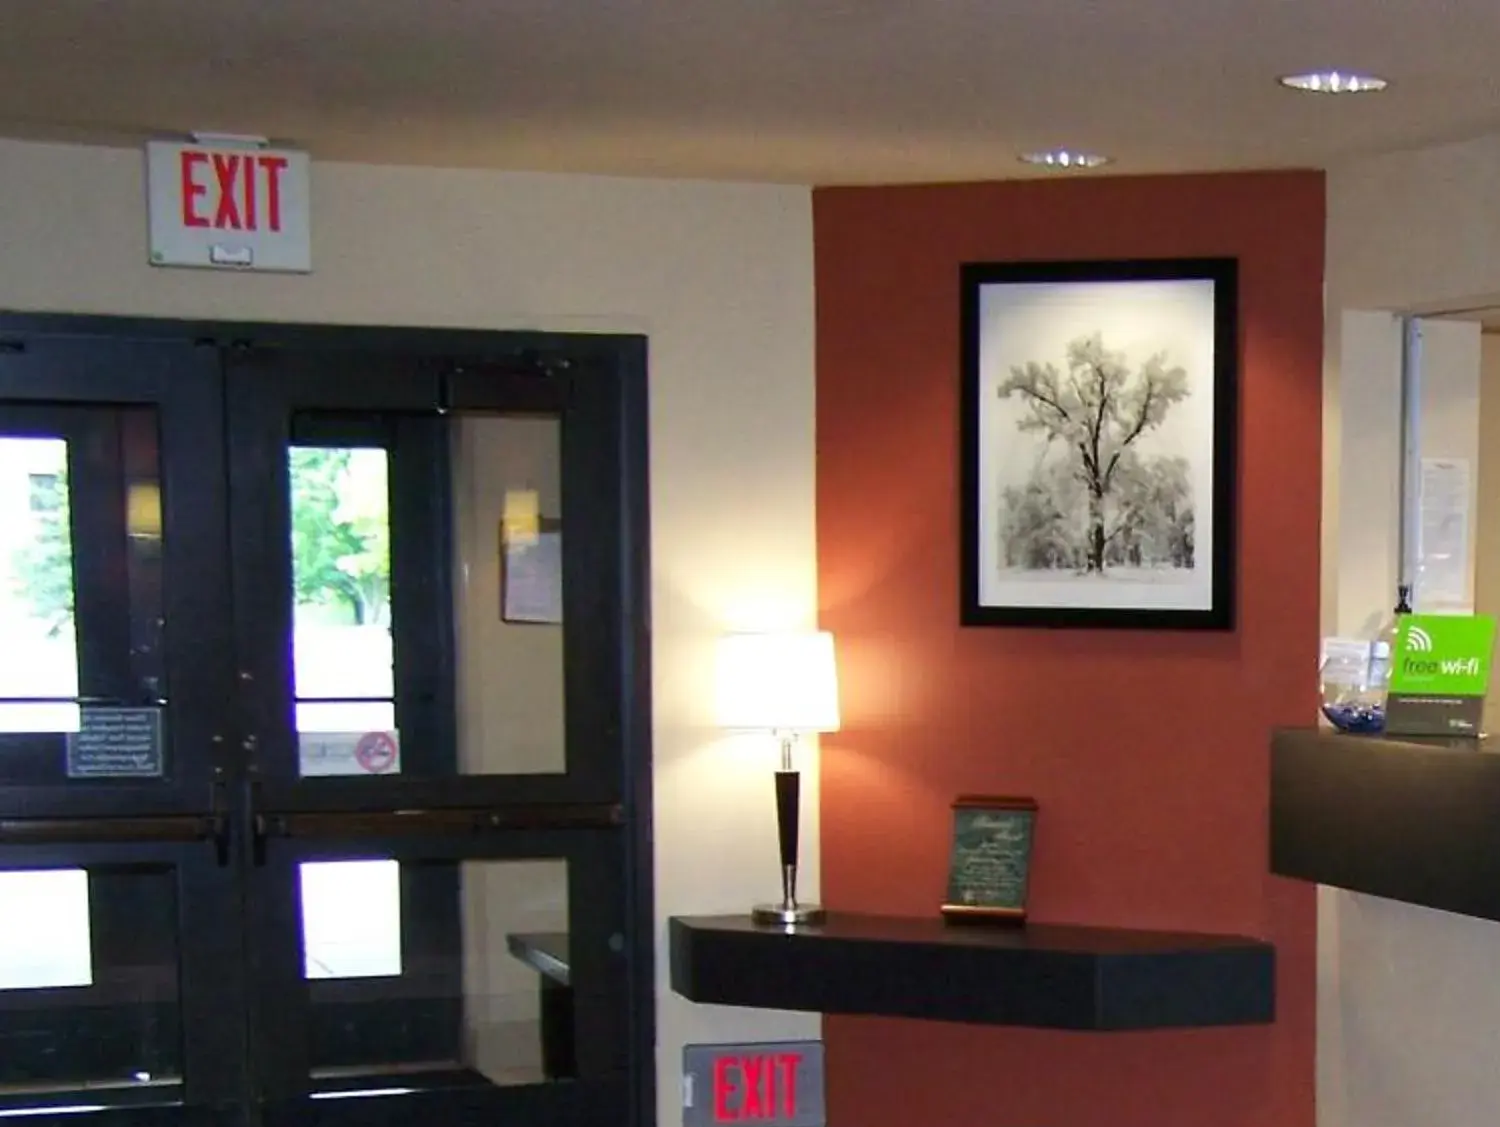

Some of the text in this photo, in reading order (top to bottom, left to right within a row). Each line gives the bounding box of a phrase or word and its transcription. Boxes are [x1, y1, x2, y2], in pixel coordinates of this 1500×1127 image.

[180, 150, 288, 232] EXIT
[1402, 656, 1479, 676] free wi-fi
[713, 1052, 803, 1123] EXIT
